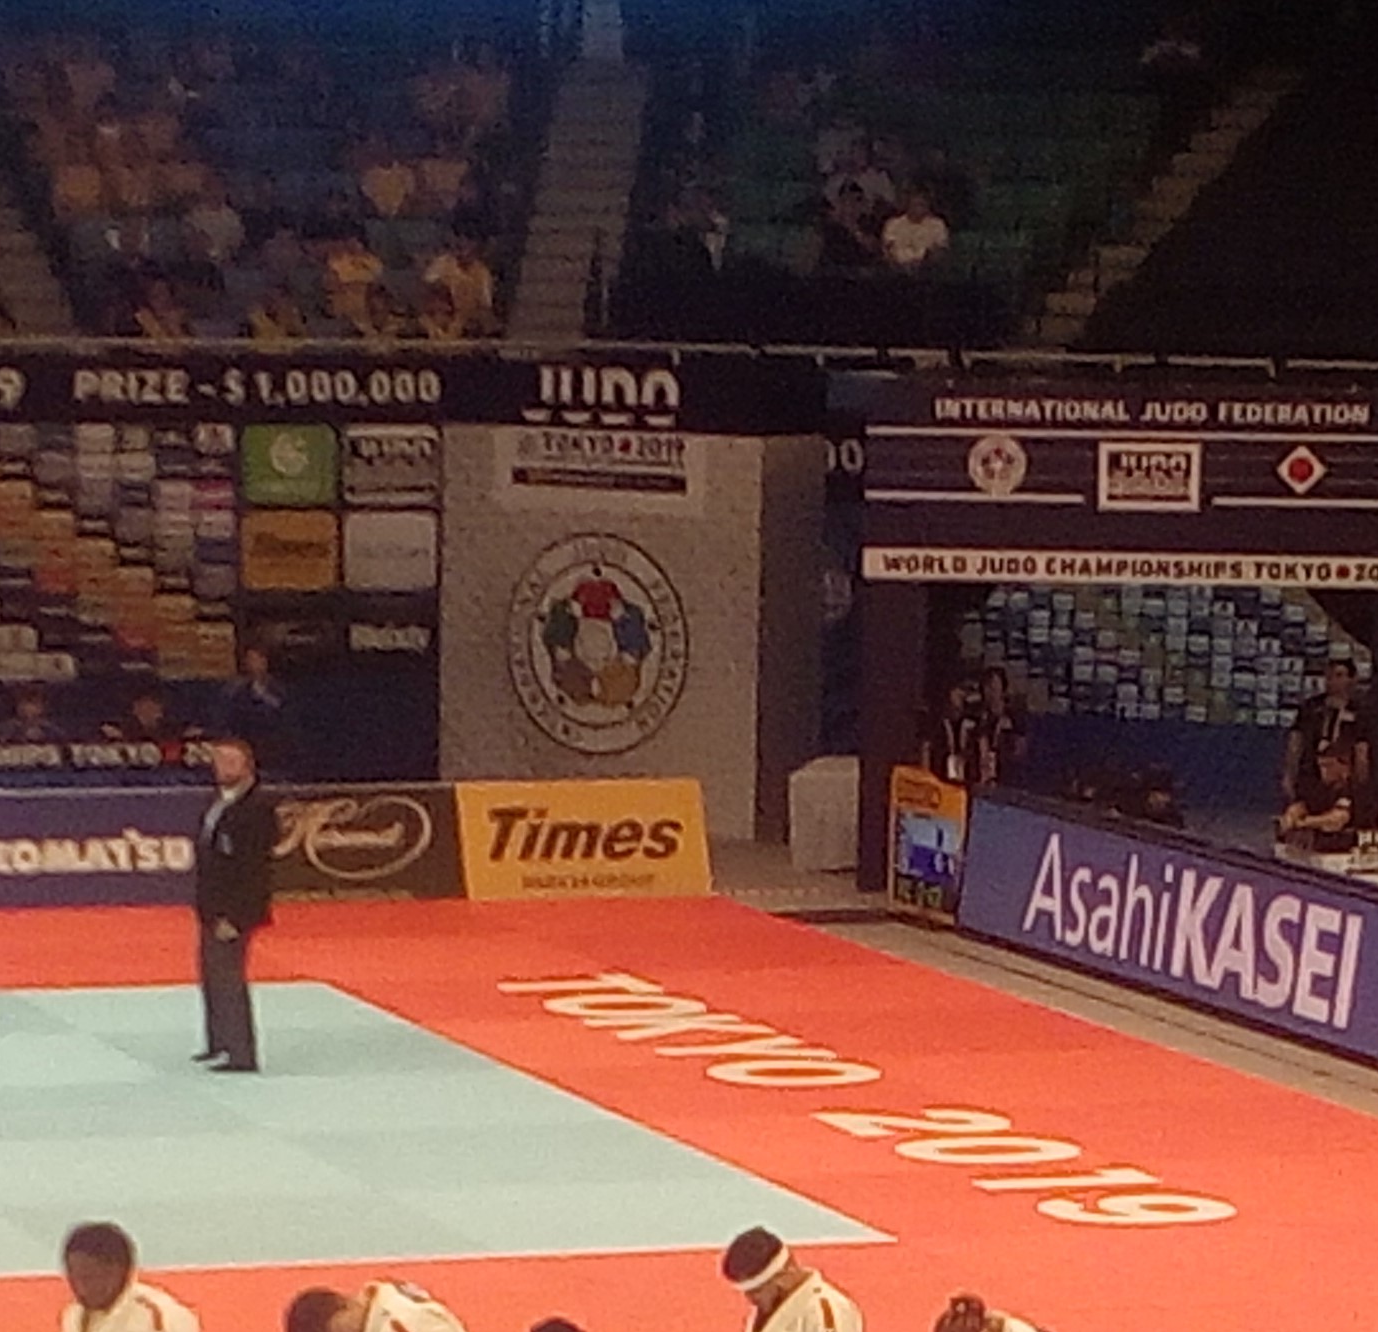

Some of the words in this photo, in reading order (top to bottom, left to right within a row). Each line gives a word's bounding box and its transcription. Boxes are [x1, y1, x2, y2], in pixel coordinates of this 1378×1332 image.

[73, 368, 190, 402] PRIZE
[934, 398, 1130, 423] INTERNATIONAL
[1139, 401, 1208, 424] JUDO
[1218, 401, 1371, 426] FEDERATION
[881, 553, 968, 574] WORLD
[975, 555, 1038, 575] JUDO
[1044, 556, 1243, 580] CHAMPIONSHIPS
[1252, 561, 1332, 582] TOKYO
[486, 806, 684, 862] Times
[1023, 833, 1364, 1029] AsahiKASEI
[496, 969, 883, 1088] TOKYO
[809, 1104, 1238, 1226] 2019
